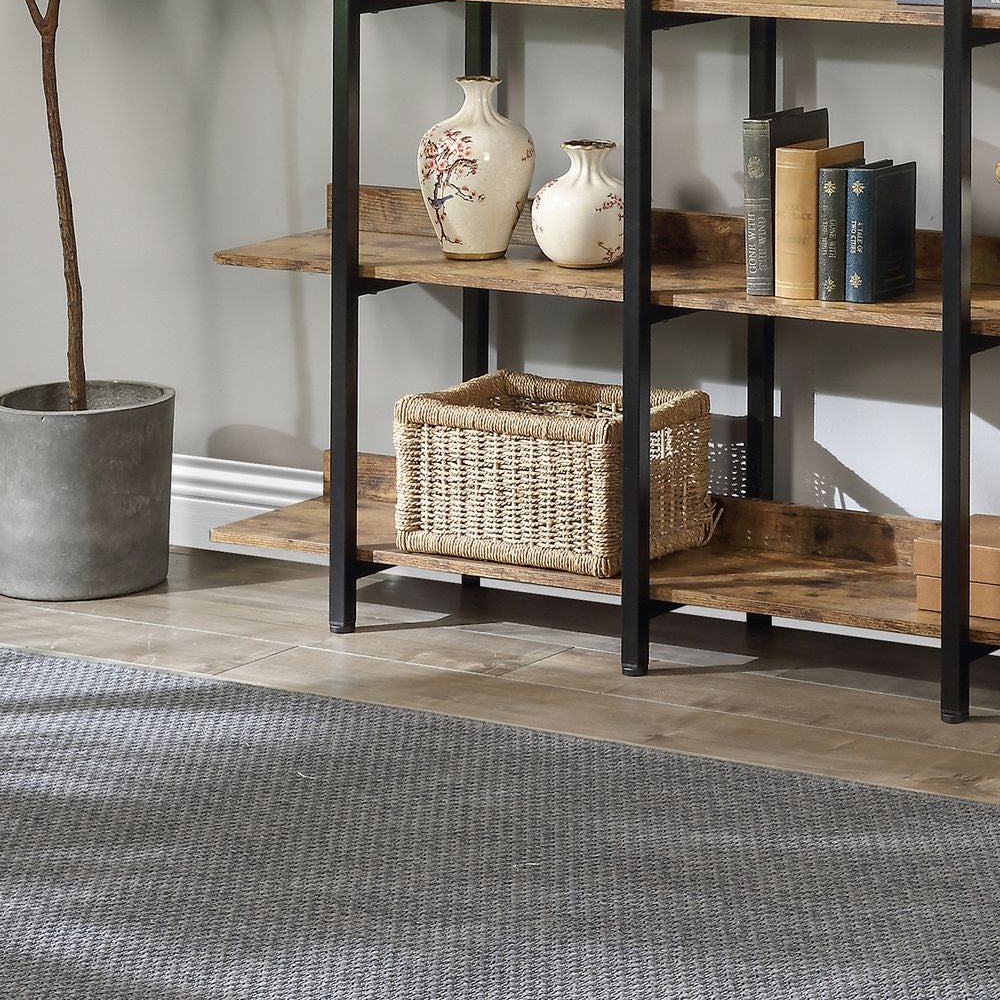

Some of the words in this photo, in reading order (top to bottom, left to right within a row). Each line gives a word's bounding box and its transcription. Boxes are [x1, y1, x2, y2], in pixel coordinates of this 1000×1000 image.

[747, 213, 756, 240] WITH
[757, 216, 766, 244] WIND
[748, 244, 757, 274] GONE
[758, 248, 767, 271] THE
